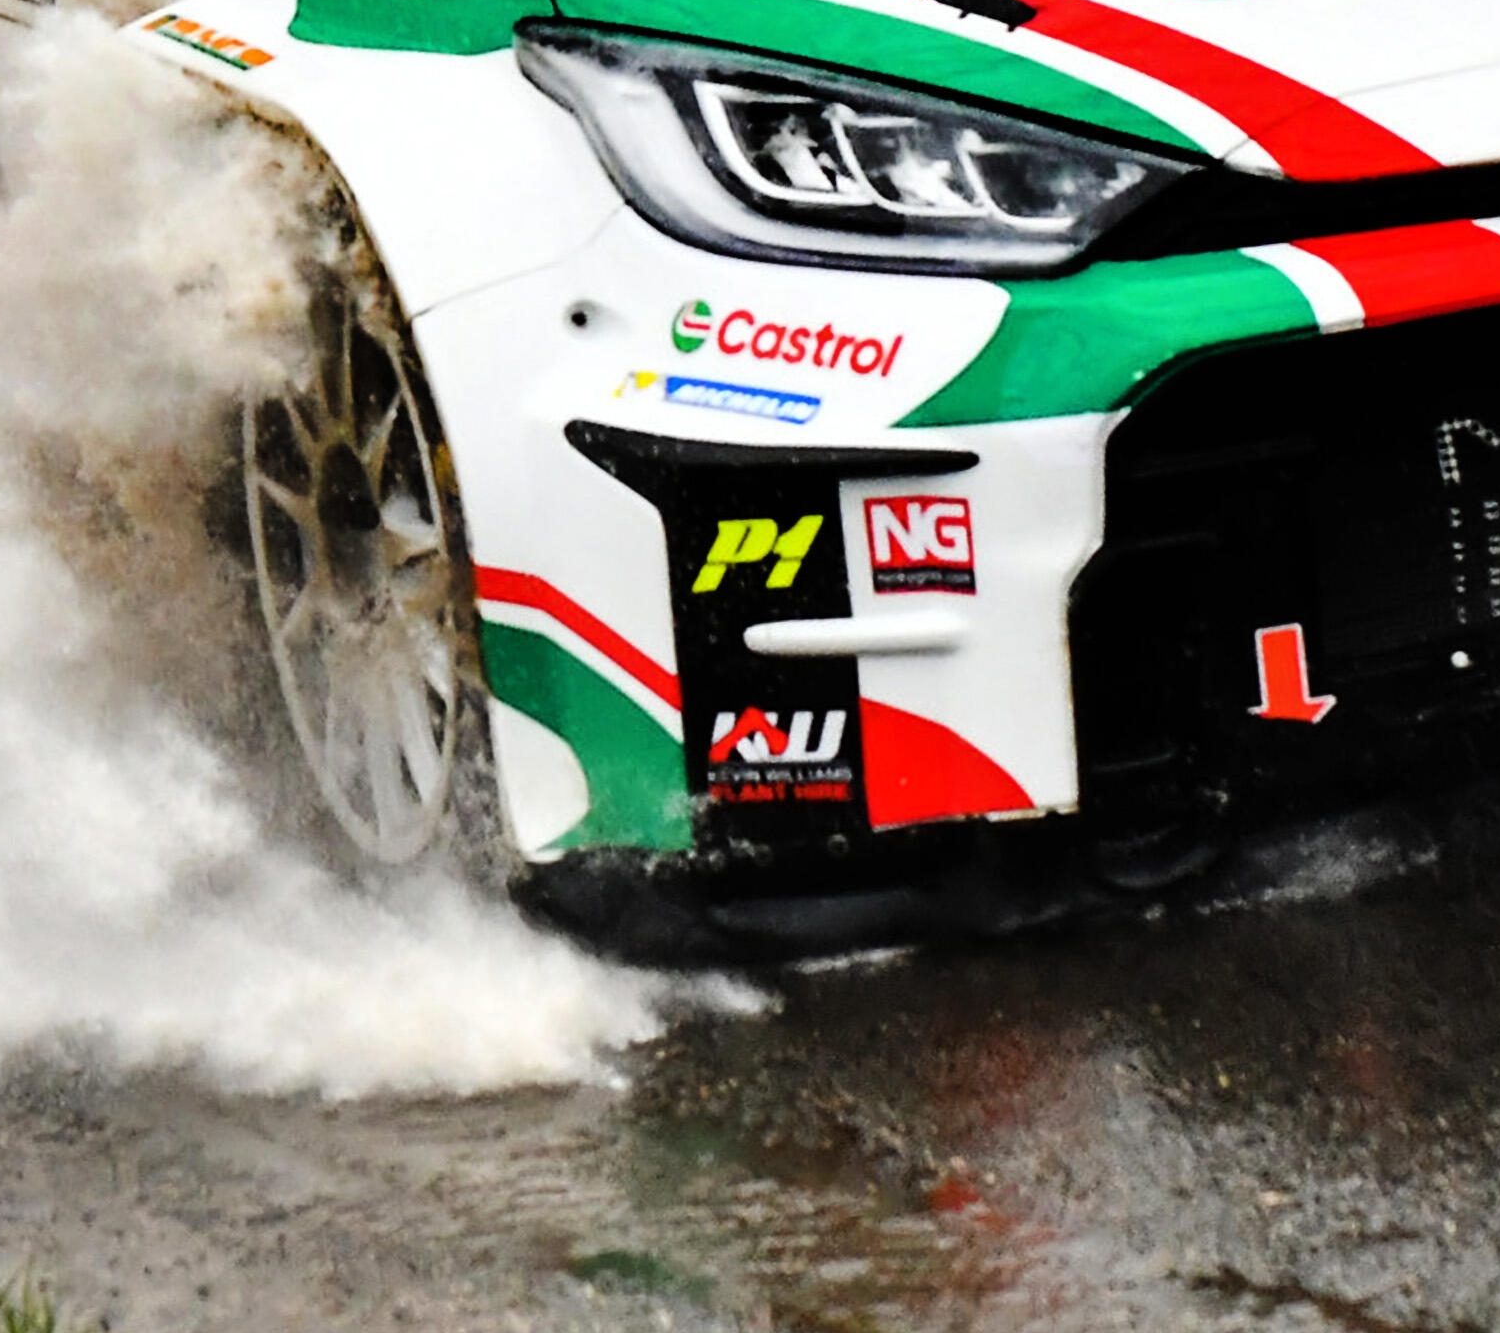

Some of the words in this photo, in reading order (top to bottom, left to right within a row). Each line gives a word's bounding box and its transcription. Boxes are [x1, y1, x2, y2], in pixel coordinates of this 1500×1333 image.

[717, 308, 904, 378] Castrol
[691, 514, 824, 593] P1
[870, 501, 971, 563] NG
